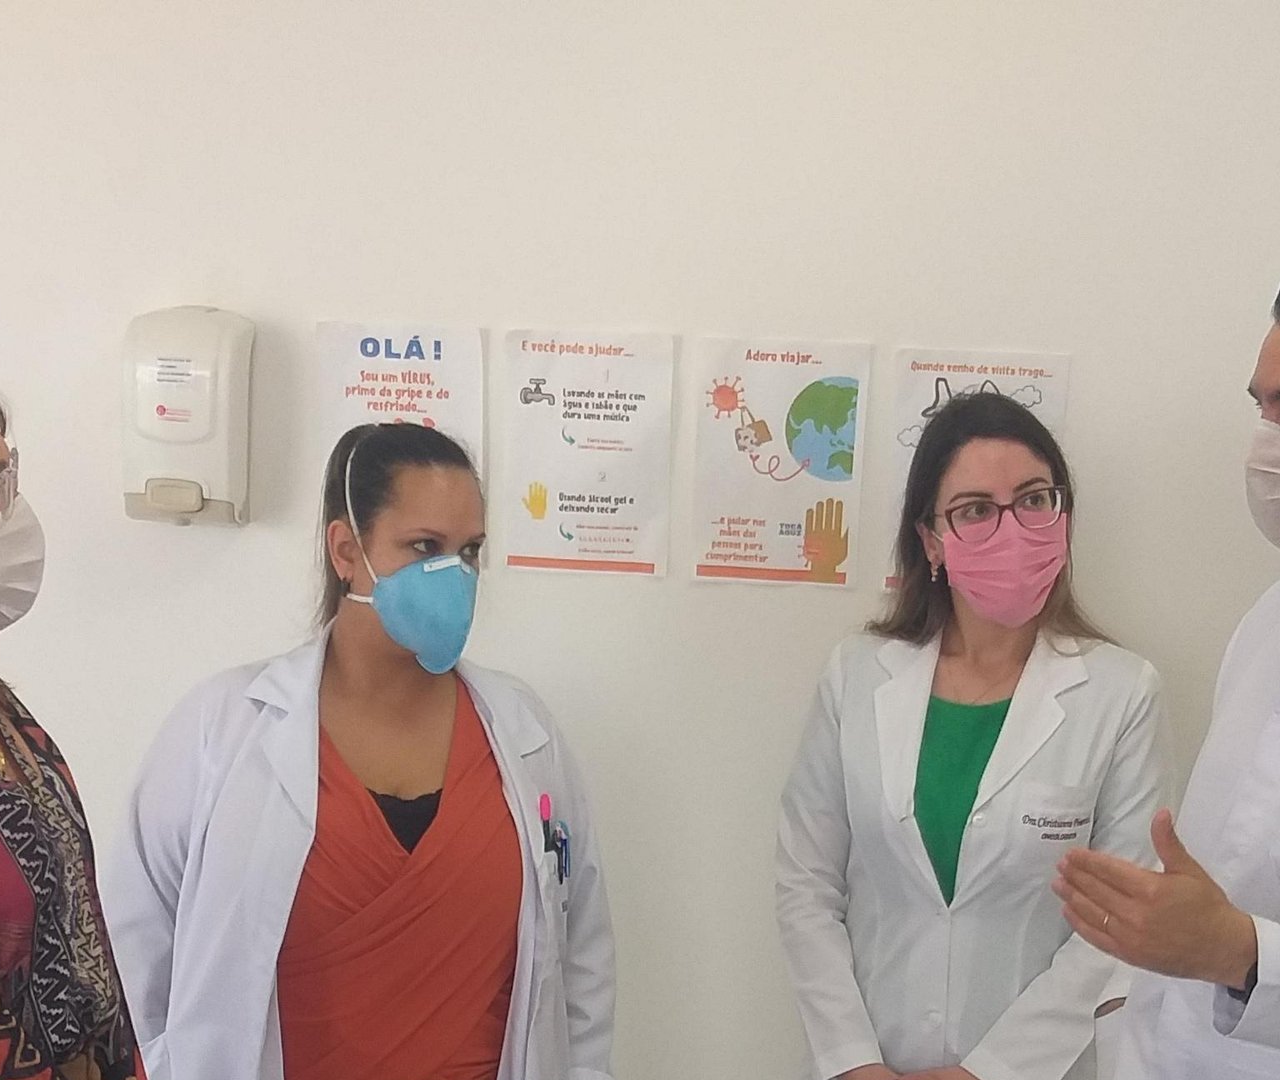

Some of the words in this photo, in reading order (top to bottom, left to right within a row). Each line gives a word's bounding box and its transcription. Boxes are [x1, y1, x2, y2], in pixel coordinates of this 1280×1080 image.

[522, 340, 528, 351] E
[531, 339, 556, 353] você
[559, 342, 584, 356] pode
[745, 349, 777, 362] Adoro
[910, 360, 944, 372] Quando
[947, 364, 974, 373] venho
[977, 365, 988, 374] de
[991, 366, 1015, 376] visita
[360, 370, 378, 382] Sou
[382, 373, 398, 383] um
[345, 385, 376, 397] primo
[379, 386, 391, 397] da
[395, 387, 422, 400] gripe
[426, 390, 433, 399] e
[436, 388, 450, 399] do
[597, 391, 605, 399] as
[607, 390, 627, 400] mãos
[629, 393, 646, 401] com
[622, 403, 637, 413] que
[562, 410, 581, 419] dura
[583, 412, 601, 421] uma
[614, 496, 627, 506] gel
[558, 503, 595, 513] deixando
